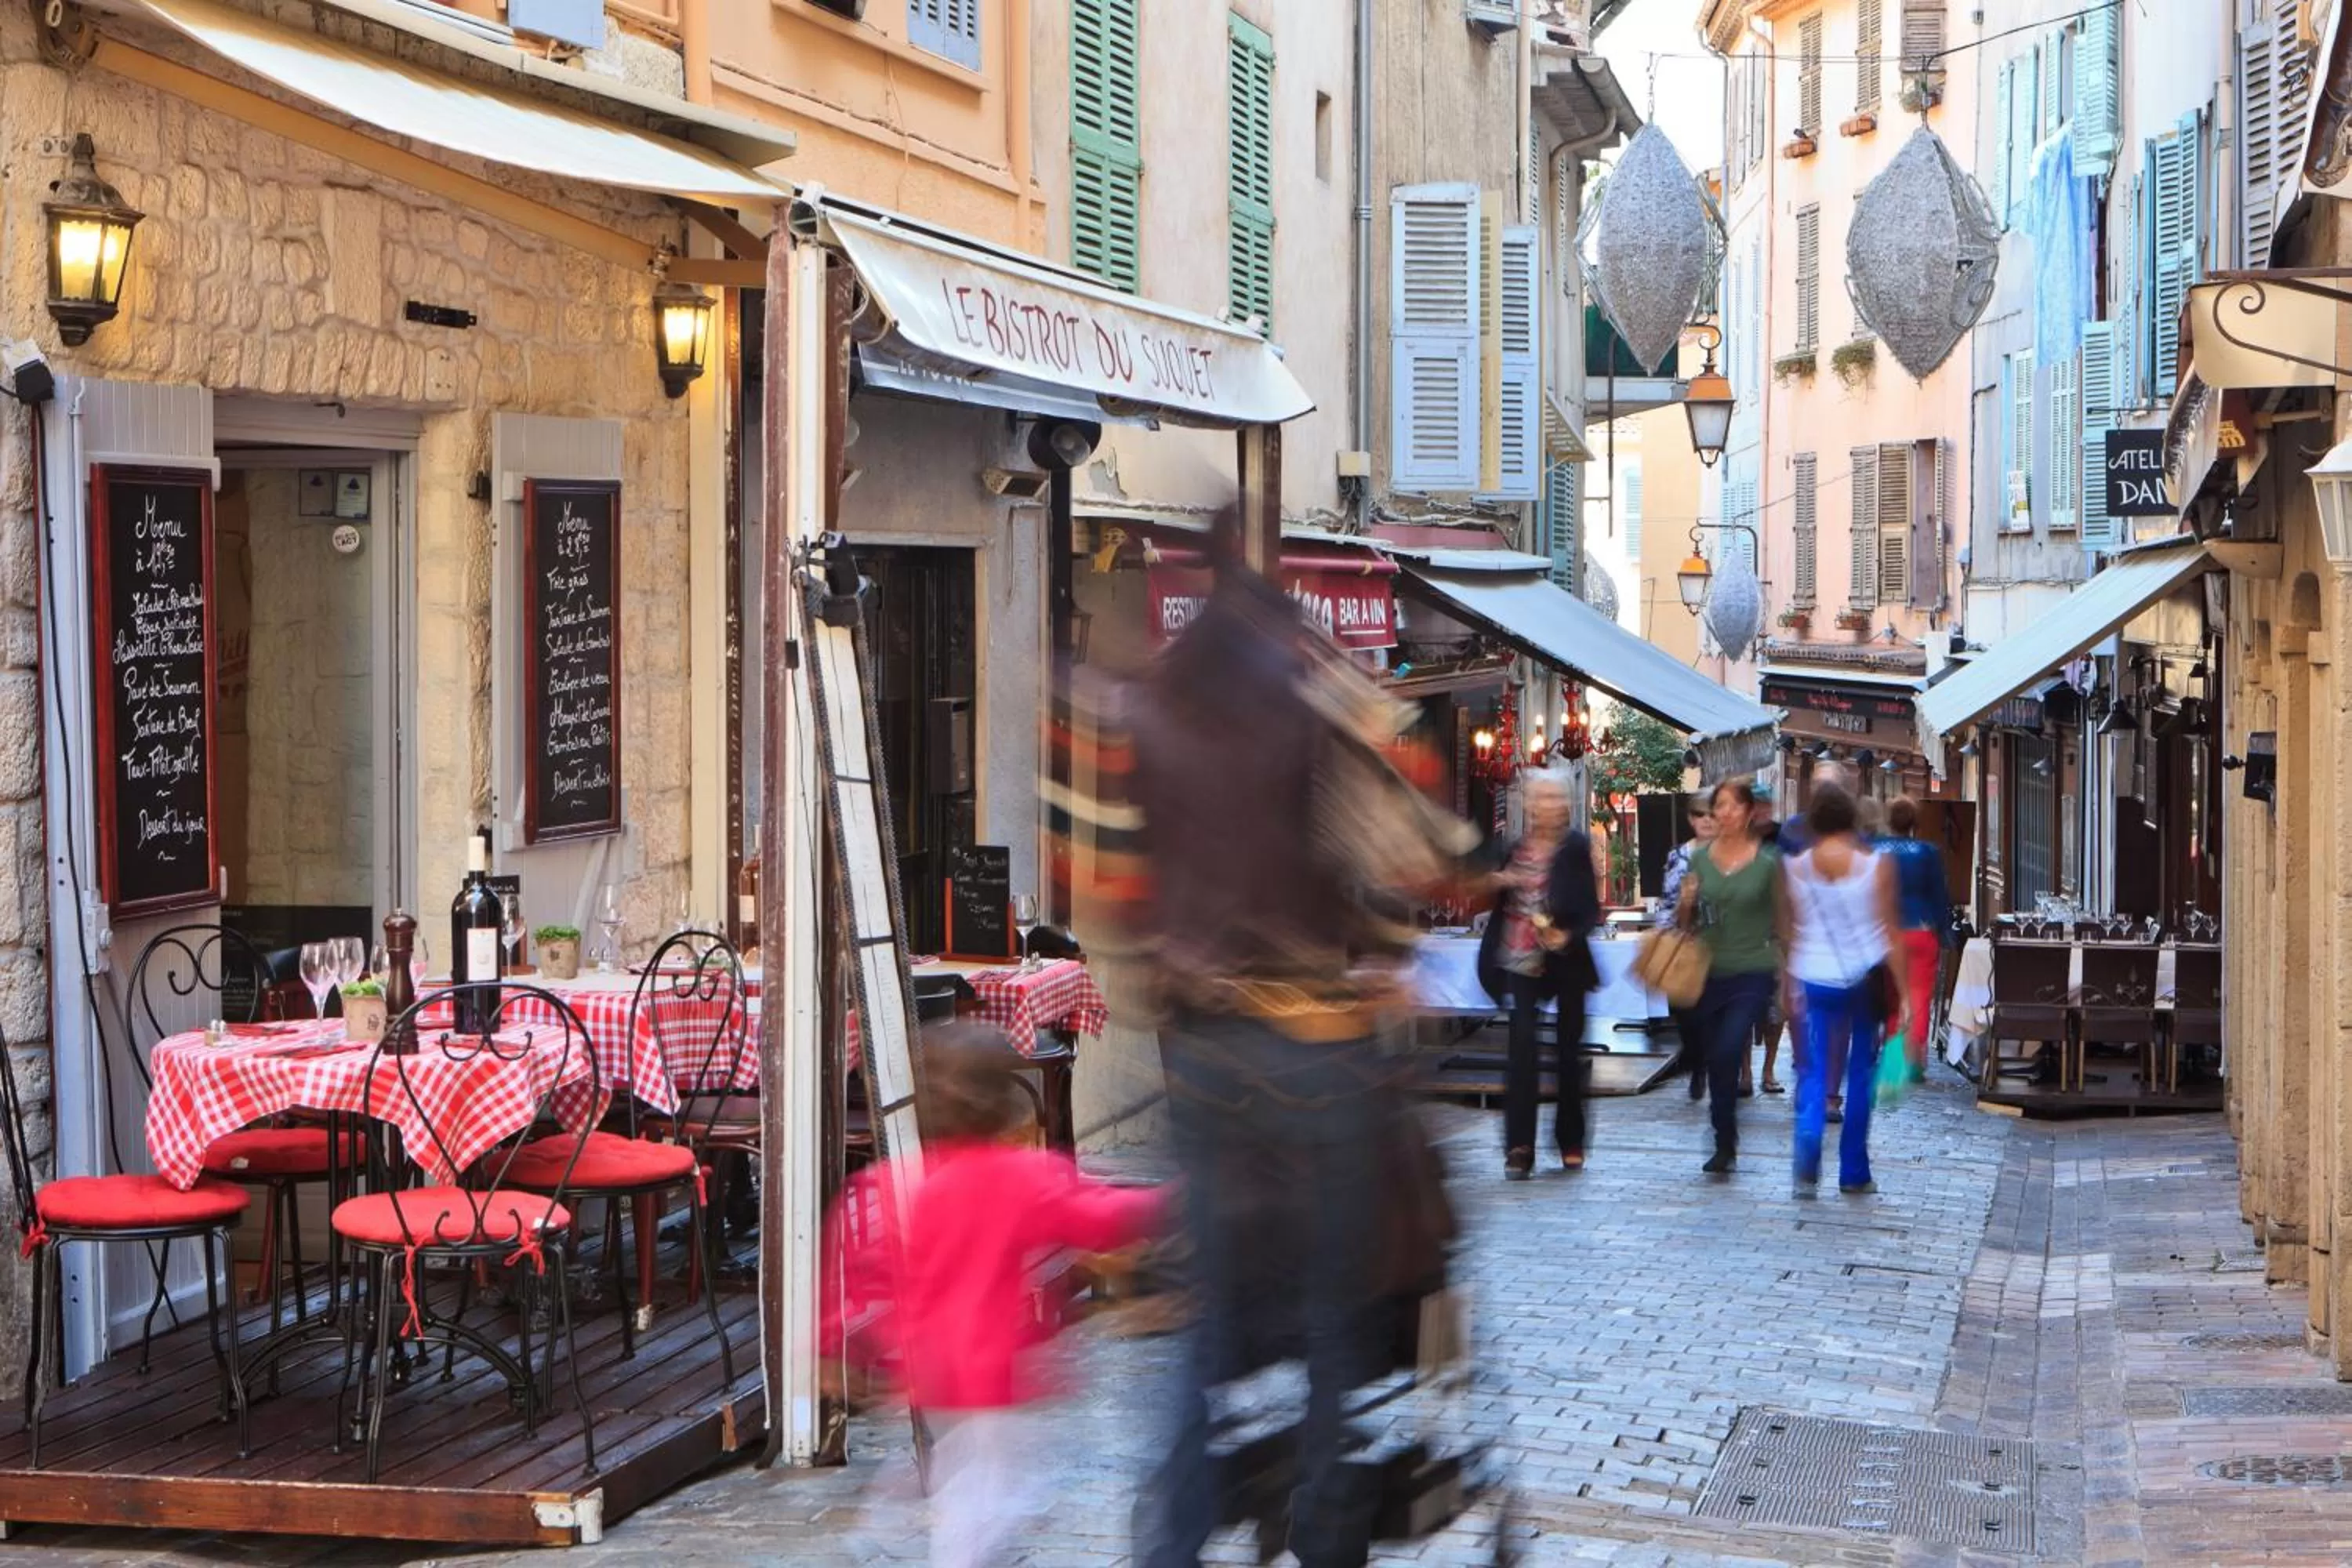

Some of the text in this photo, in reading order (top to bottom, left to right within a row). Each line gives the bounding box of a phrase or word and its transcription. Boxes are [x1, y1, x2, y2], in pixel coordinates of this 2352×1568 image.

[942, 278, 983, 347] LE
[982, 288, 1083, 375] BISTROT
[1091, 318, 1133, 383] DU
[1141, 334, 1215, 402] SUQUET
[136, 494, 187, 539] Menu
[557, 501, 593, 534] Menu
[1339, 597, 1360, 625] BAR
